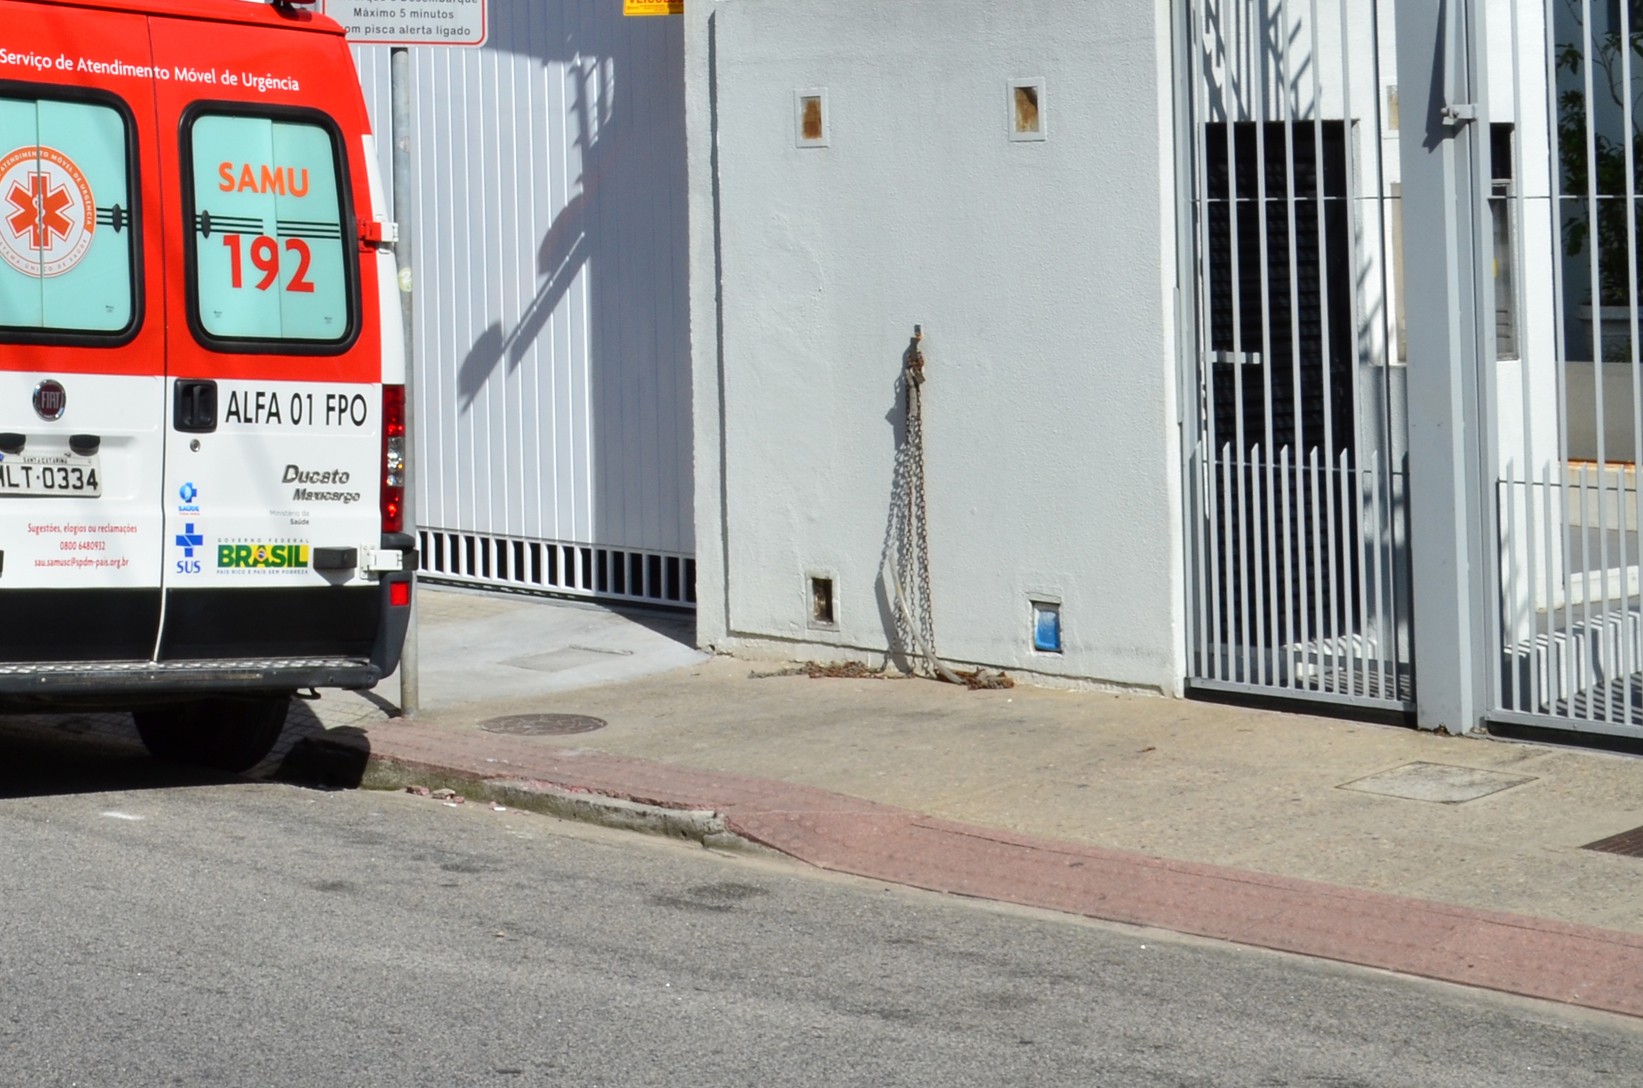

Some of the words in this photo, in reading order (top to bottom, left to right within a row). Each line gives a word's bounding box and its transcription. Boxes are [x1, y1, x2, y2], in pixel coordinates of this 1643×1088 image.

[354, 8, 396, 18] Máximo
[400, 9, 406, 18] 5
[410, 10, 454, 19] minutos
[365, 25, 395, 36] pisca
[399, 25, 432, 35] alerta
[436, 26, 470, 38] ligado
[55, 54, 74, 70] de
[77, 58, 170, 80] Atendimento
[174, 66, 216, 84] Móvel
[220, 70, 238, 86] de
[242, 73, 300, 92] Urgência
[0, 150, 50, 172] ATENDIMENTO
[51, 153, 74, 172] MÓVEL
[73, 172, 82, 182] DE
[218, 162, 308, 198] SAMU
[58, 262, 66, 270] DE
[222, 234, 314, 293] 192
[42, 391, 60, 409] FIAT
[225, 390, 282, 425] ALFA
[290, 392, 313, 426] 01
[326, 393, 368, 426] FPO
[282, 464, 350, 484] Ducato
[292, 488, 361, 504] Maxicargo
[64, 522, 86, 536] elogios
[98, 522, 137, 535] reclamações
[60, 541, 77, 550] 0800
[78, 541, 105, 550] 6480932
[218, 544, 309, 568] BRASIL
[176, 560, 201, 574] SUS
